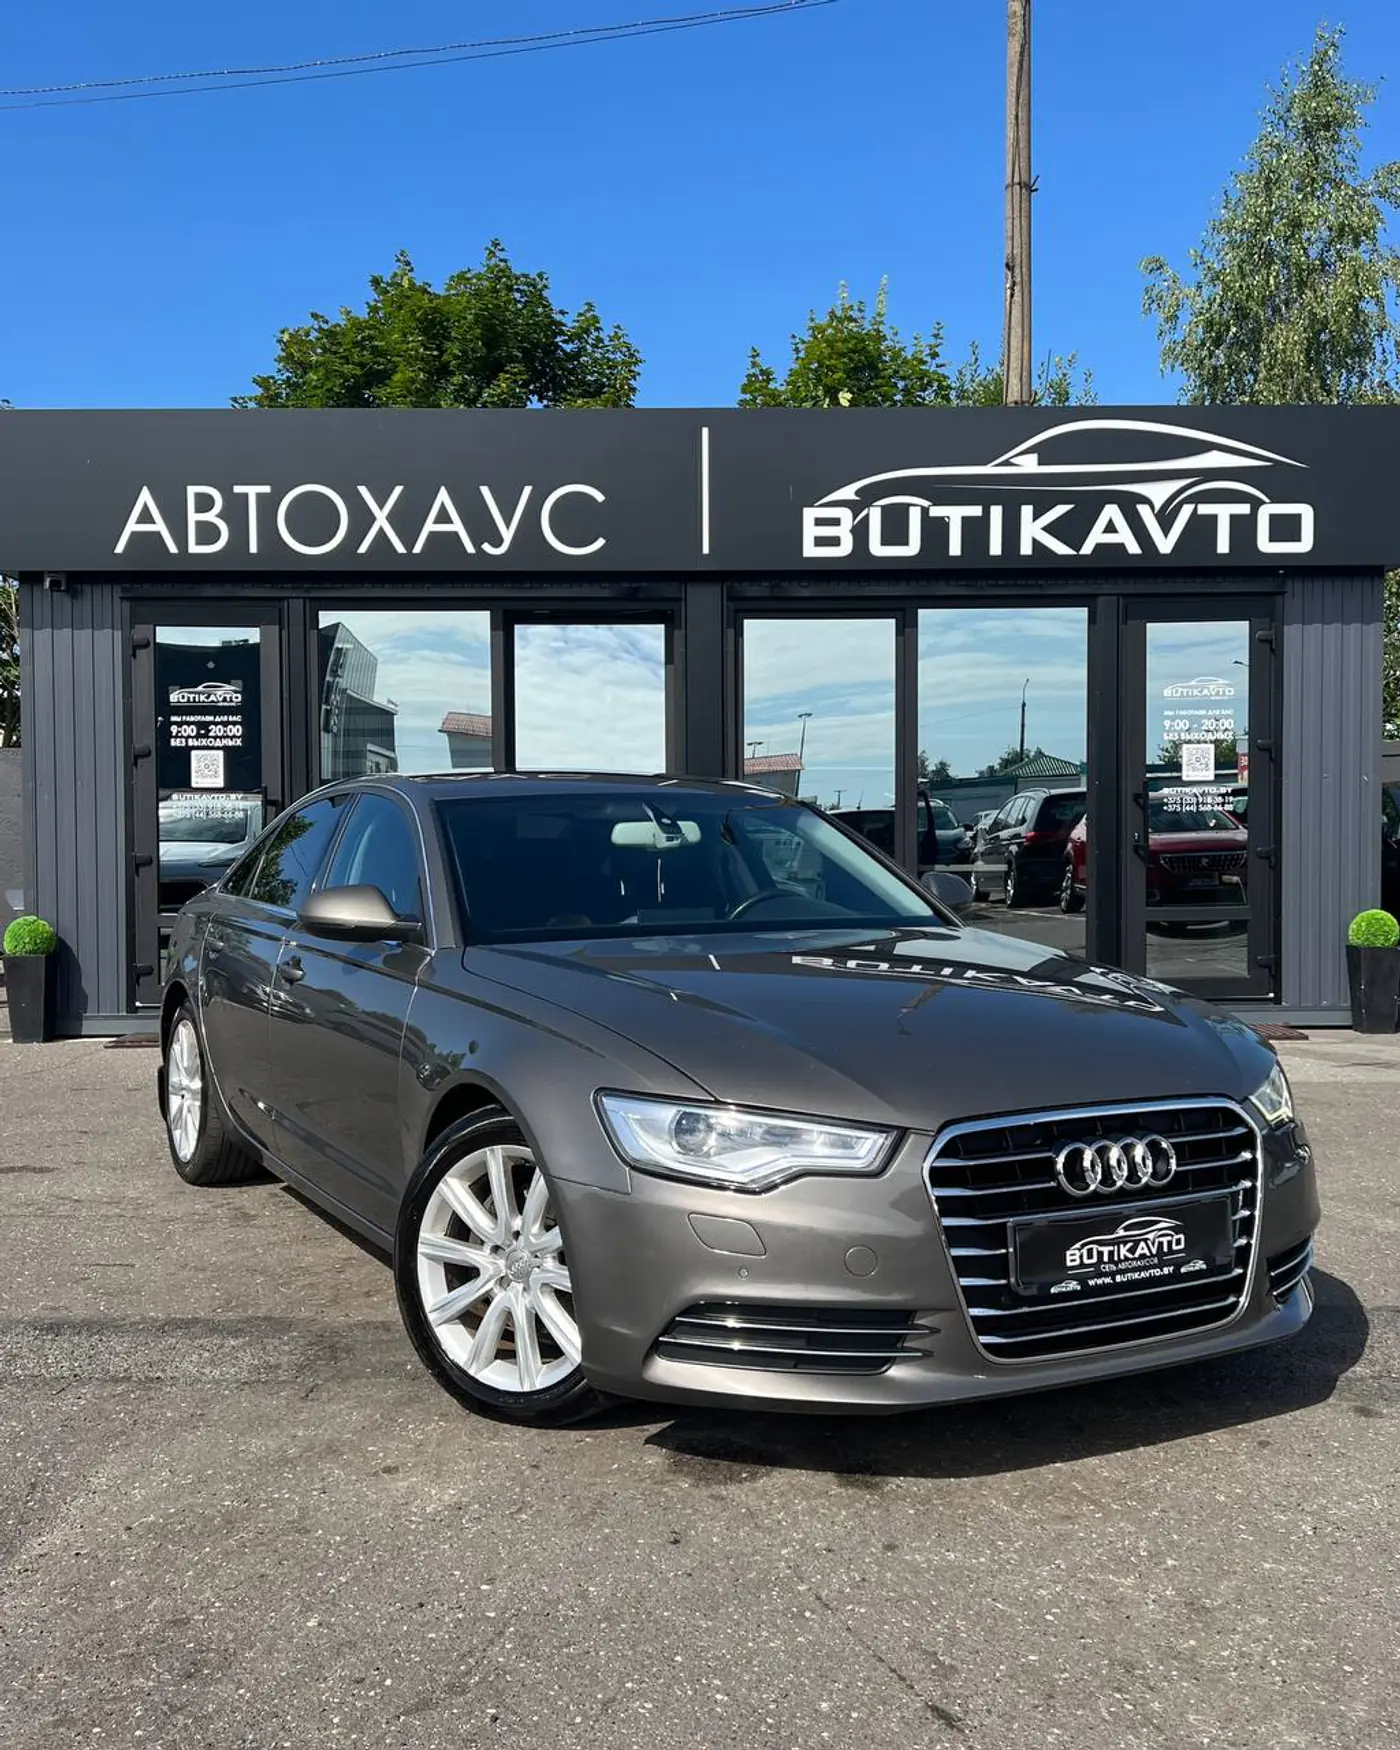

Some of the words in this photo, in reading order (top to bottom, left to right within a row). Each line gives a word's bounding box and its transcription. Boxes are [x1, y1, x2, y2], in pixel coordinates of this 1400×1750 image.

[114, 484, 607, 555] АВТОХАУС
[803, 502, 1315, 558] BUTIKAVTO
[170, 724, 197, 737] 9:00
[208, 724, 243, 737] 20:00
[1163, 719, 1190, 731] 9:00
[1201, 719, 1235, 731] 20:00
[1180, 731, 1235, 741] ВЫХОДНЫХ
[170, 738, 186, 747] БЕЗ
[187, 738, 242, 748] ВЫХОДНЫХ
[1065, 1233, 1186, 1267] BUTIKAVTO
